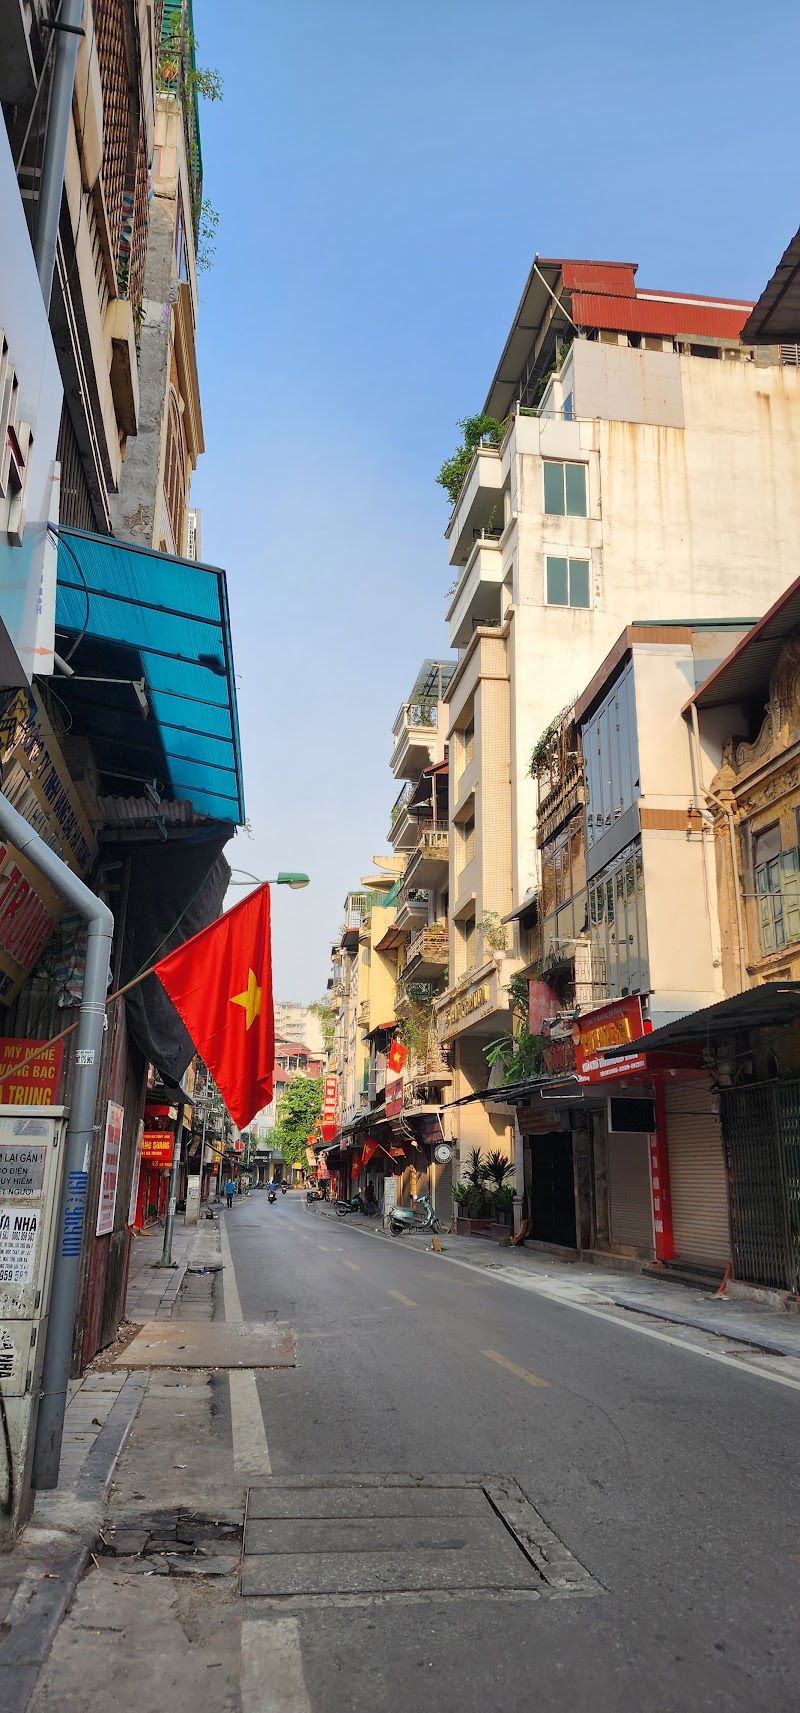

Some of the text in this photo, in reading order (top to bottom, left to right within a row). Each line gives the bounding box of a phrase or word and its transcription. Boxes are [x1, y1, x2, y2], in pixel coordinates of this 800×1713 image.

[52, 788, 72, 826] VÀNG
[0, 864, 54, 971] TRUNG
[4, 1045, 56, 1064] MỸ NGHỆ
[33, 1066, 56, 1081] BẠC
[4, 1153, 18, 1165] LẠI
[20, 1150, 38, 1163] GẦN
[9, 1186, 34, 1196] NGƯỜI
[13, 1214, 37, 1232] NHÀ
